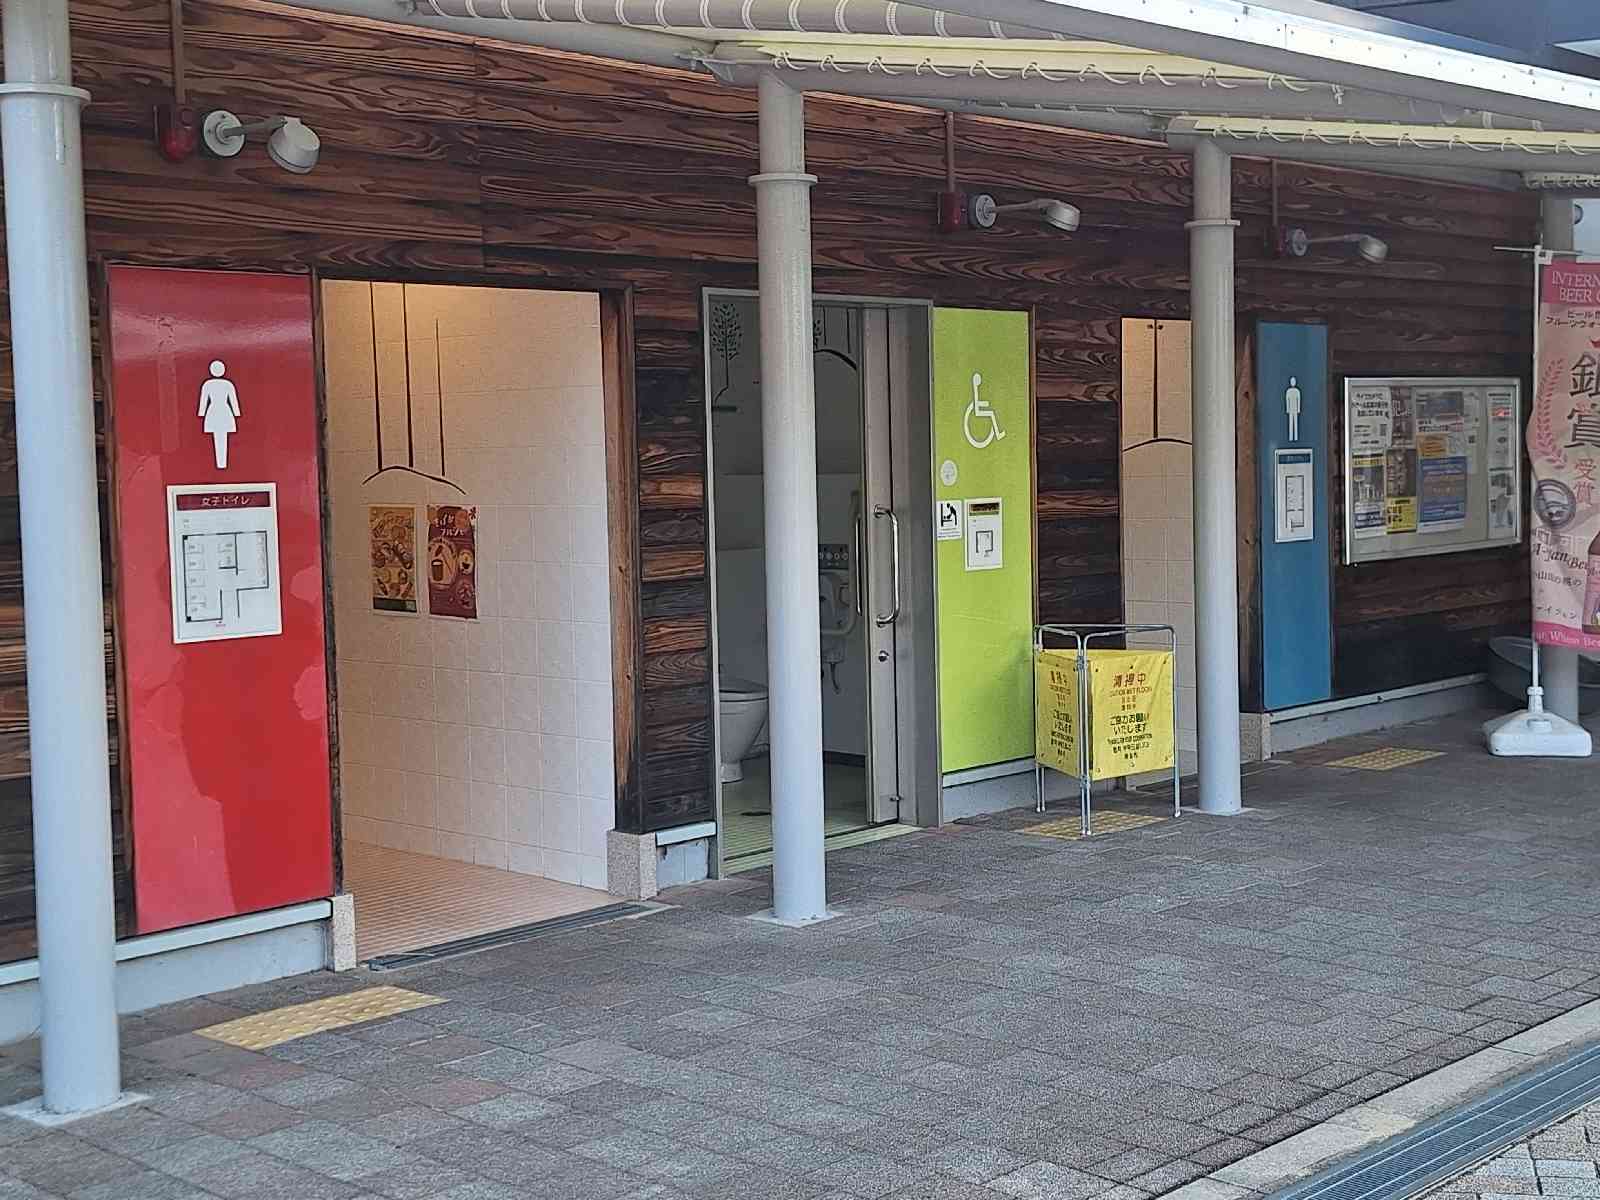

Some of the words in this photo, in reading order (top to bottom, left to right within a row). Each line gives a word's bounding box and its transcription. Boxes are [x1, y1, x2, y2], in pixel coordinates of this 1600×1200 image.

[1559, 288, 1593, 303] BEER
[201, 495, 250, 507] 女子トイレ
[1113, 673, 1147, 689] 清掃中
[1113, 723, 1147, 735] いたします
